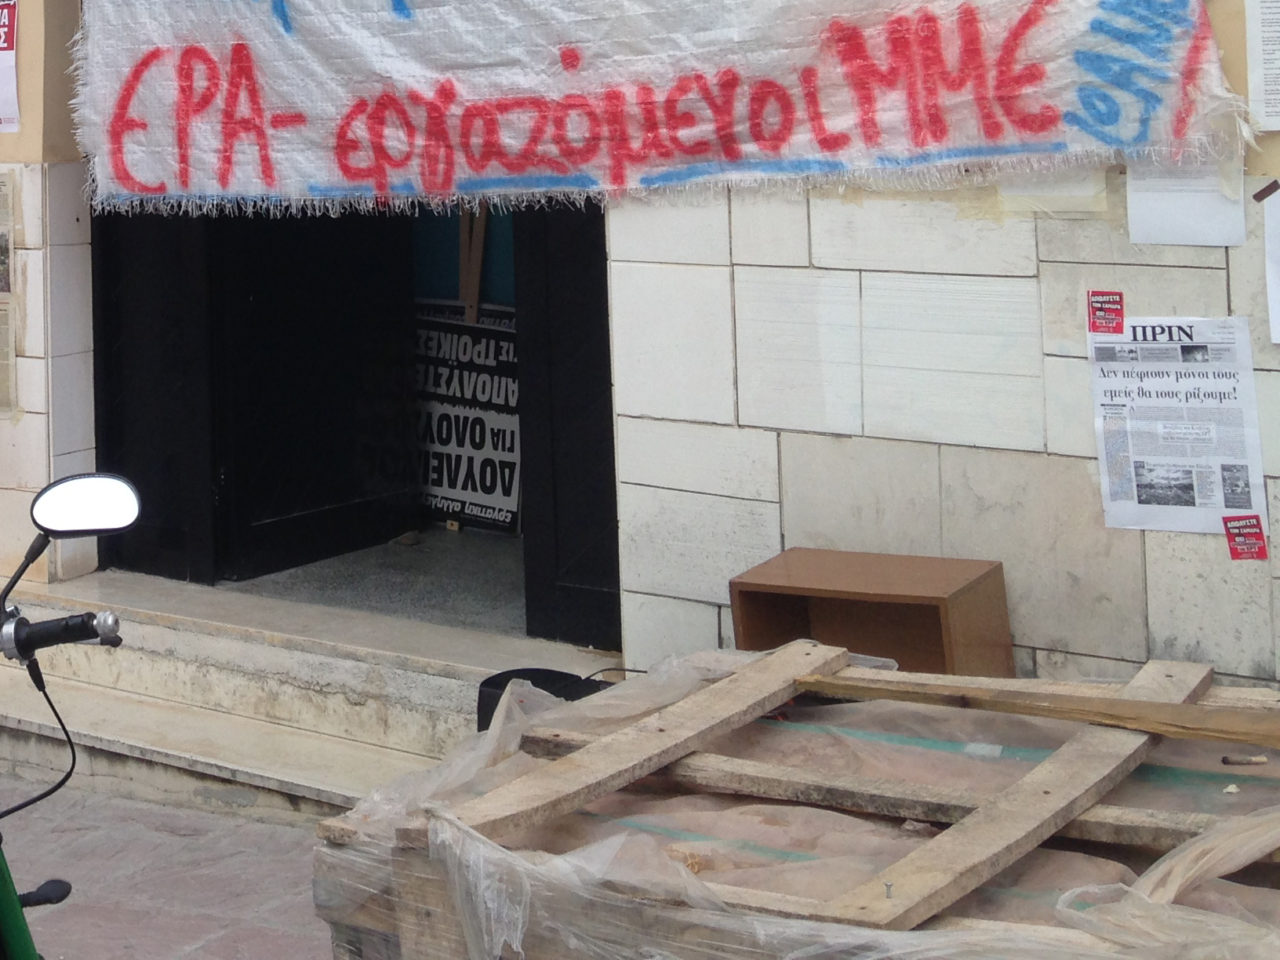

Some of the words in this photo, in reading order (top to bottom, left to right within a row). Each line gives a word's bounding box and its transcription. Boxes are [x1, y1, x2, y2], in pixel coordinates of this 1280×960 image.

[1131, 325, 1194, 342] ΠΡΙΝ
[416, 363, 519, 408] ΑΠΟΛΥΣΤΕ
[1098, 367, 1118, 379] Δεν
[420, 411, 486, 451] ΟΛΟΥ
[490, 428, 515, 453] ΓΙΑ
[422, 450, 517, 498] ΔΟΥΛΕΙ
